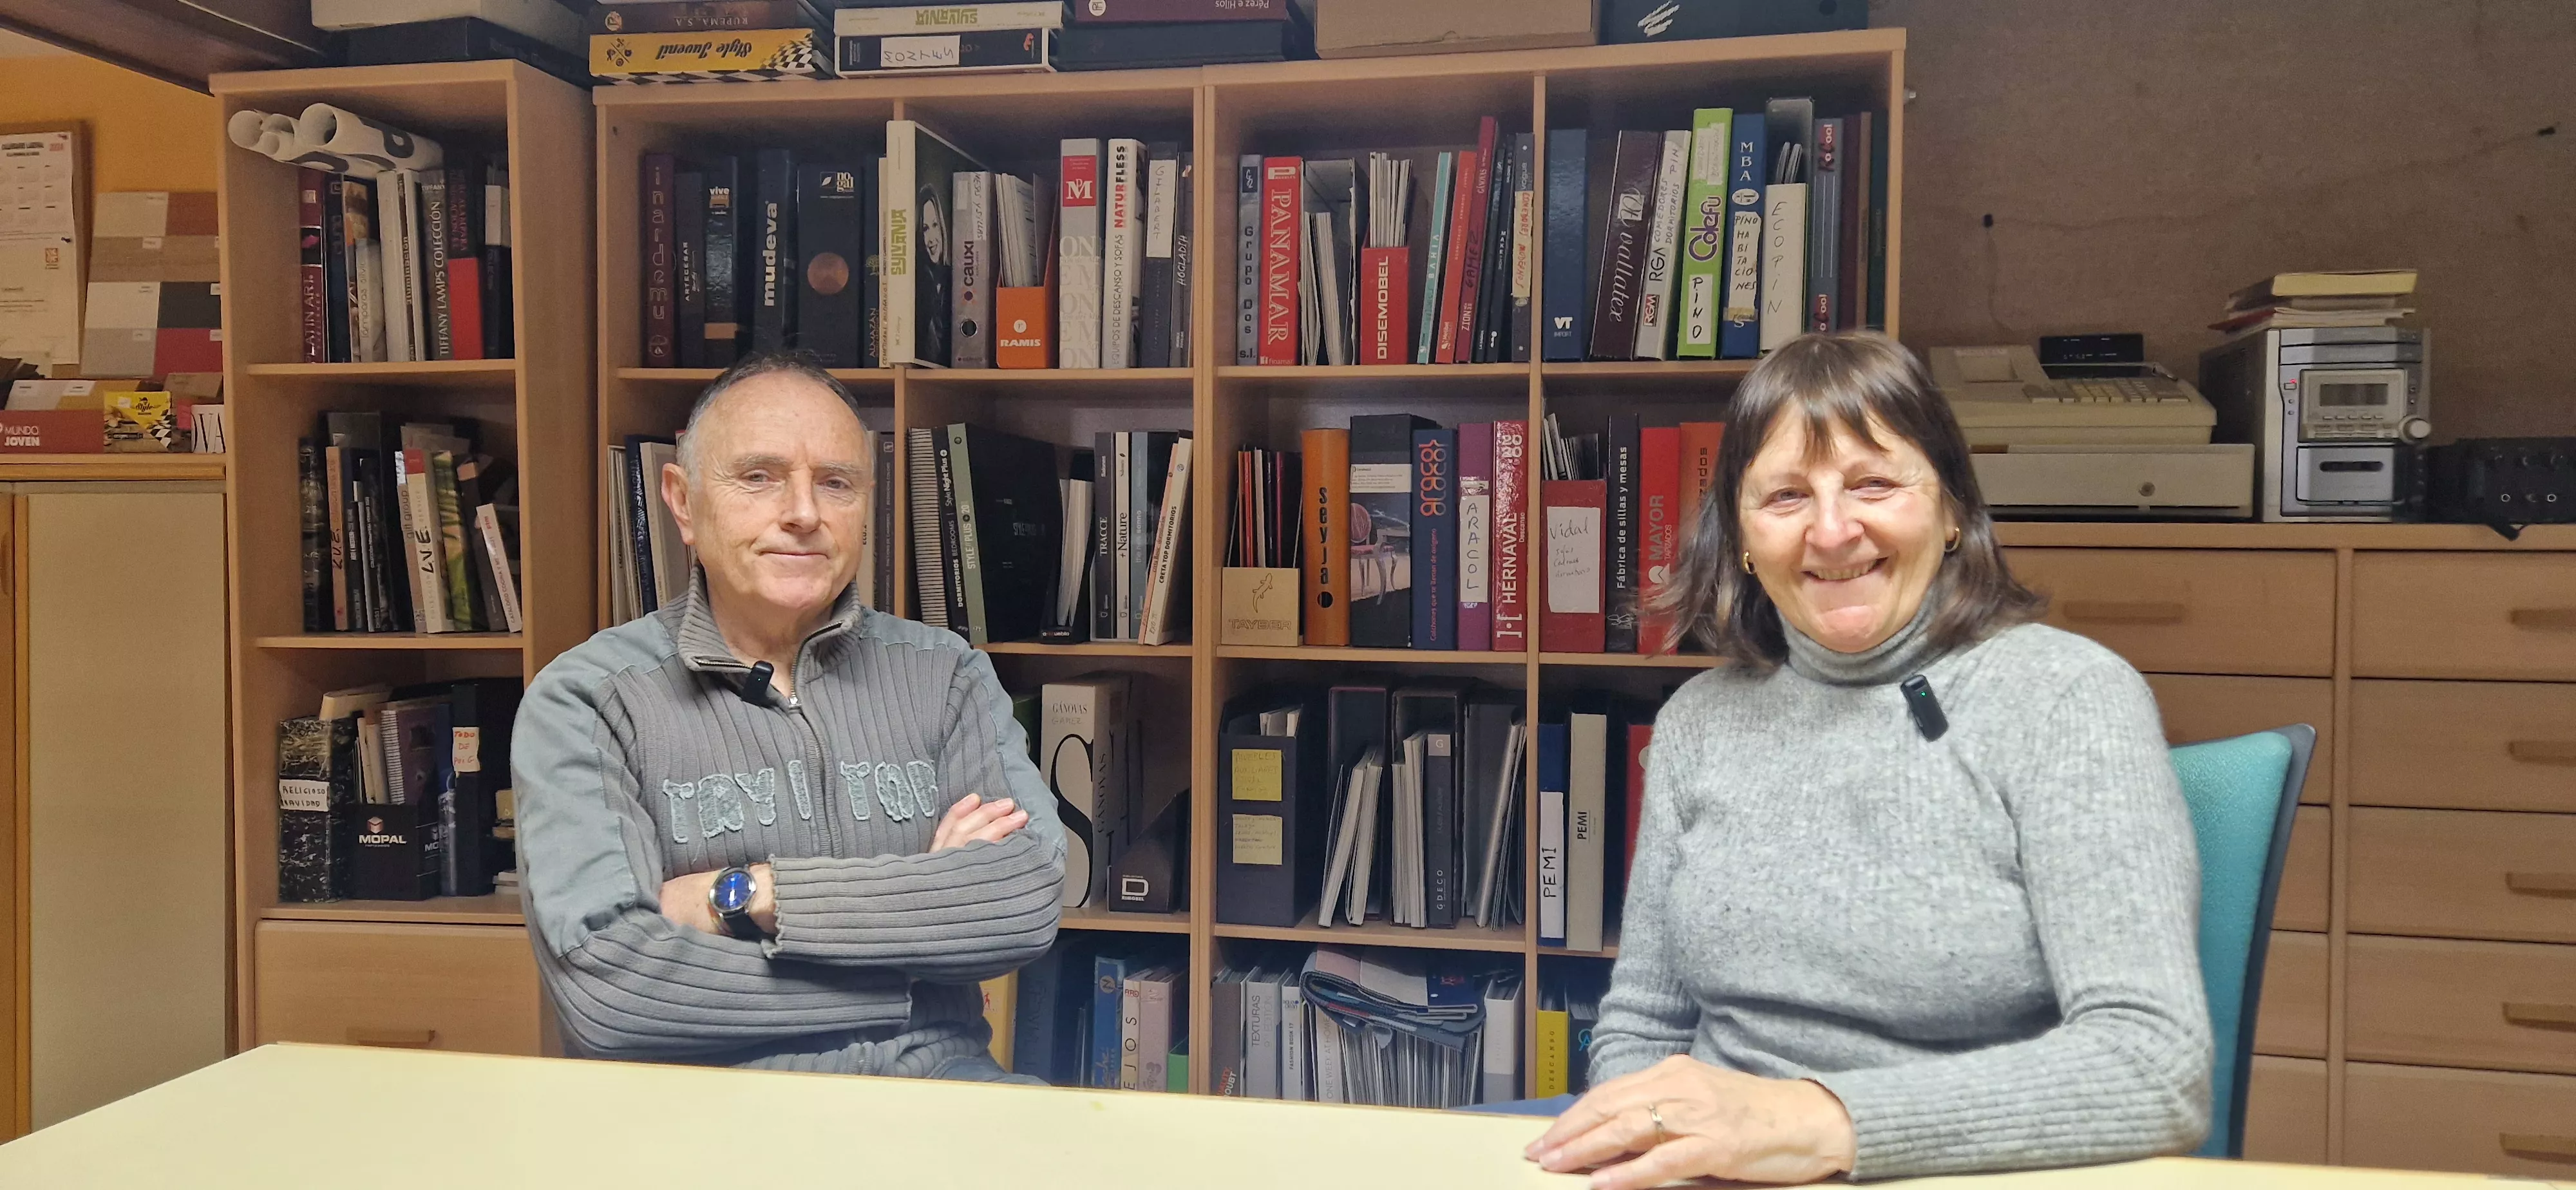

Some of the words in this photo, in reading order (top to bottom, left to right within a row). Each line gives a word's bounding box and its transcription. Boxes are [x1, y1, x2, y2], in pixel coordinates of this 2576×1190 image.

[915, 8, 978, 25] SYLVANIA
[655, 42, 712, 61] Juvenil
[715, 41, 753, 59] Style
[1114, 145, 1126, 229] NATURFLESS
[430, 201, 444, 268] COLECCIÓN
[762, 203, 779, 307] mudeva
[891, 208, 907, 276] SYLVANIA
[1244, 225, 1254, 285] Grupo
[963, 240, 975, 287] cauxi
[1267, 189, 1292, 345] PANAMAR
[434, 270, 447, 309] LAMPS
[1113, 270, 1122, 315] DESCANSO
[1376, 256, 1389, 360] DISEMOBEL
[1692, 278, 1704, 339] PINO
[1244, 299, 1253, 334] Dos
[1813, 294, 1828, 332] oCool
[437, 312, 450, 356] TIFFANY
[999, 338, 1042, 347] RAMIS
[5, 425, 39, 435] MUNDO
[5, 436, 40, 447] JOVEN
[1620, 446, 1628, 484] mesas
[1117, 511, 1128, 550] Nature
[1164, 505, 1178, 550] DORMITORIOS
[1617, 495, 1627, 527] sillas
[1648, 495, 1664, 561] MAYOR
[950, 519, 960, 558] BEDROOMS
[1099, 516, 1108, 557] TRACCE
[1161, 549, 1170, 564] TOP
[1466, 502, 1481, 590] ARACOL
[1617, 530, 1626, 543] de
[953, 558, 964, 608] DORMITORIOS
[1159, 565, 1168, 584] CRETA
[1616, 546, 1626, 589] Fábrica
[1228, 618, 1292, 630] TAYBER
[358, 834, 408, 845] MOPAL
[1577, 811, 1587, 840] PEMI
[1436, 869, 1444, 911] GDECO
[1541, 847, 1558, 898] PEMI
[1251, 994, 1261, 1048] TEXTURAS
